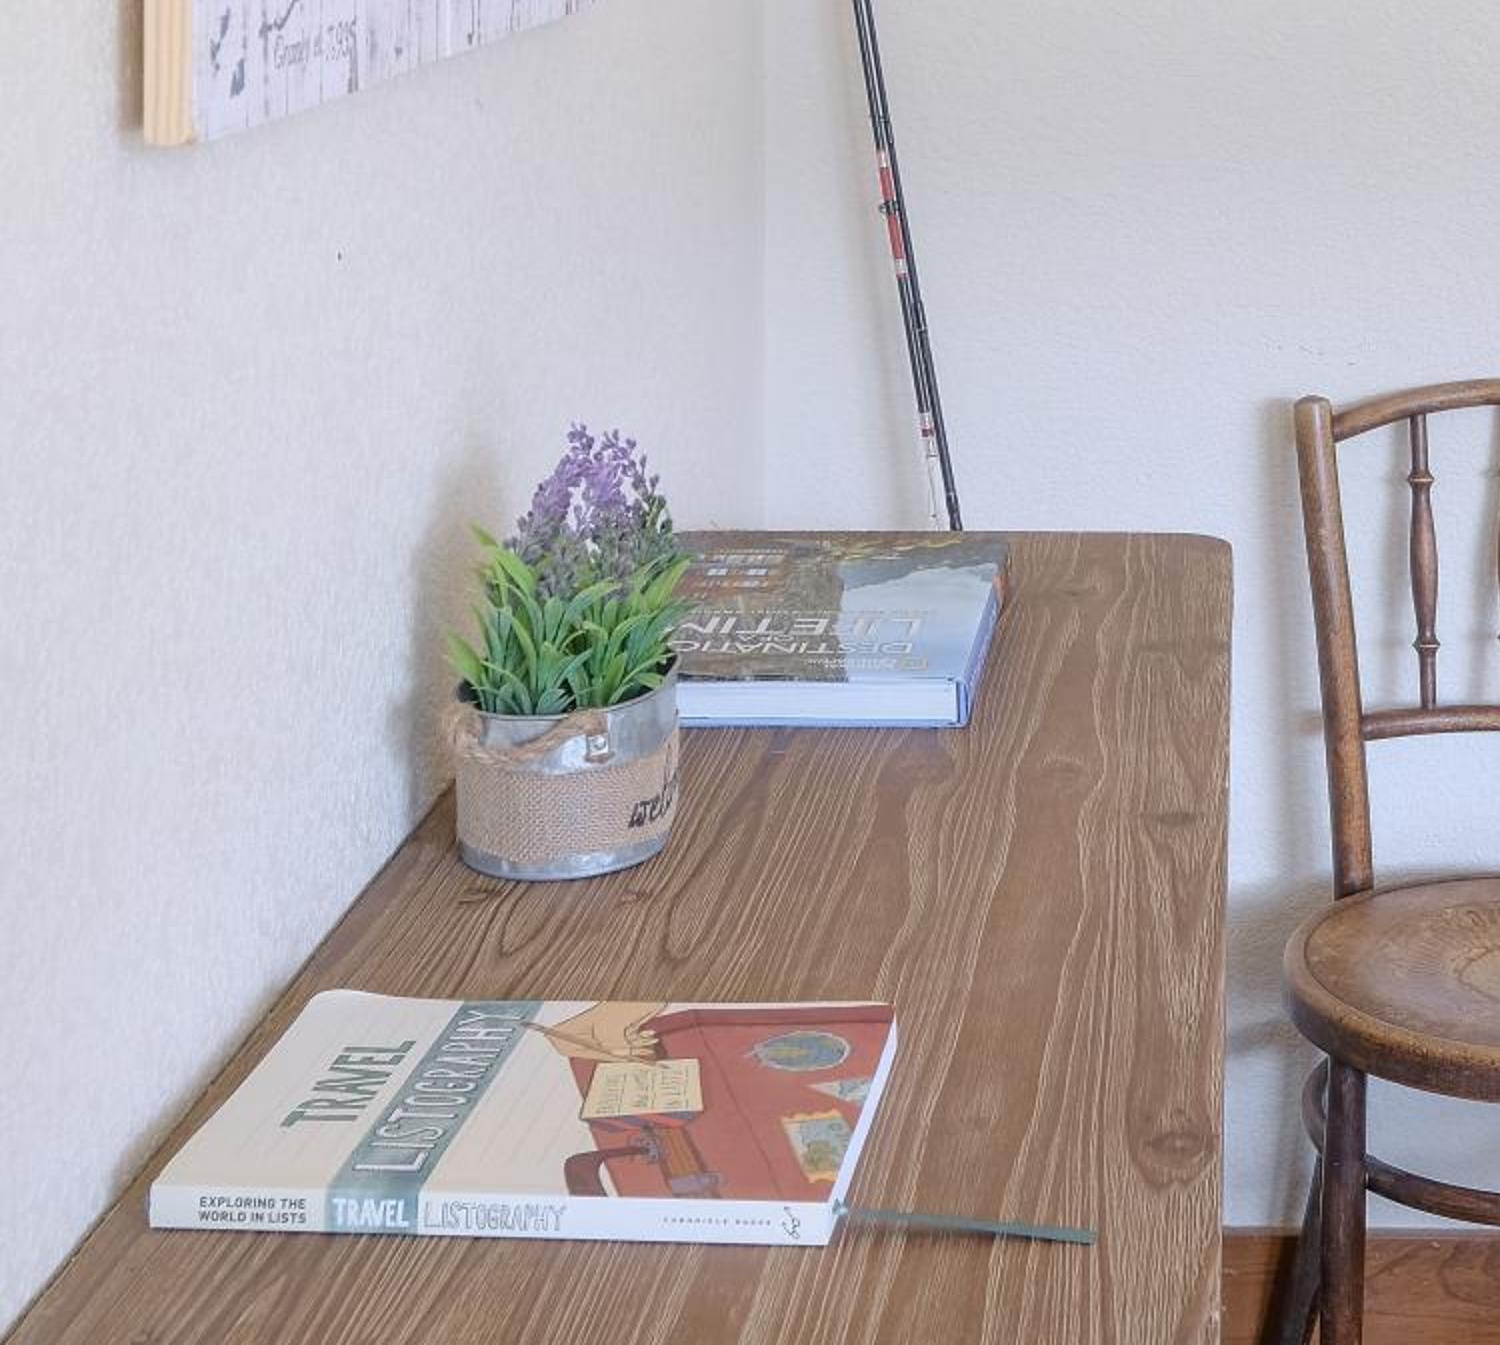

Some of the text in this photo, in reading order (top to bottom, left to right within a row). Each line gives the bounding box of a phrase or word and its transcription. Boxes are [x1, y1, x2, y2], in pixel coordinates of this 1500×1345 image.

[668, 640, 913, 654] DESTINATIO
[279, 1039, 417, 1128] TRAVEL
[352, 1009, 524, 1173] LISTOGRAPHY
[199, 1196, 307, 1211] EXPLORING THE
[332, 1198, 568, 1233] TRAVEL LISTOGRAPHY
[197, 1210, 307, 1225] WORLD IN LISTS
